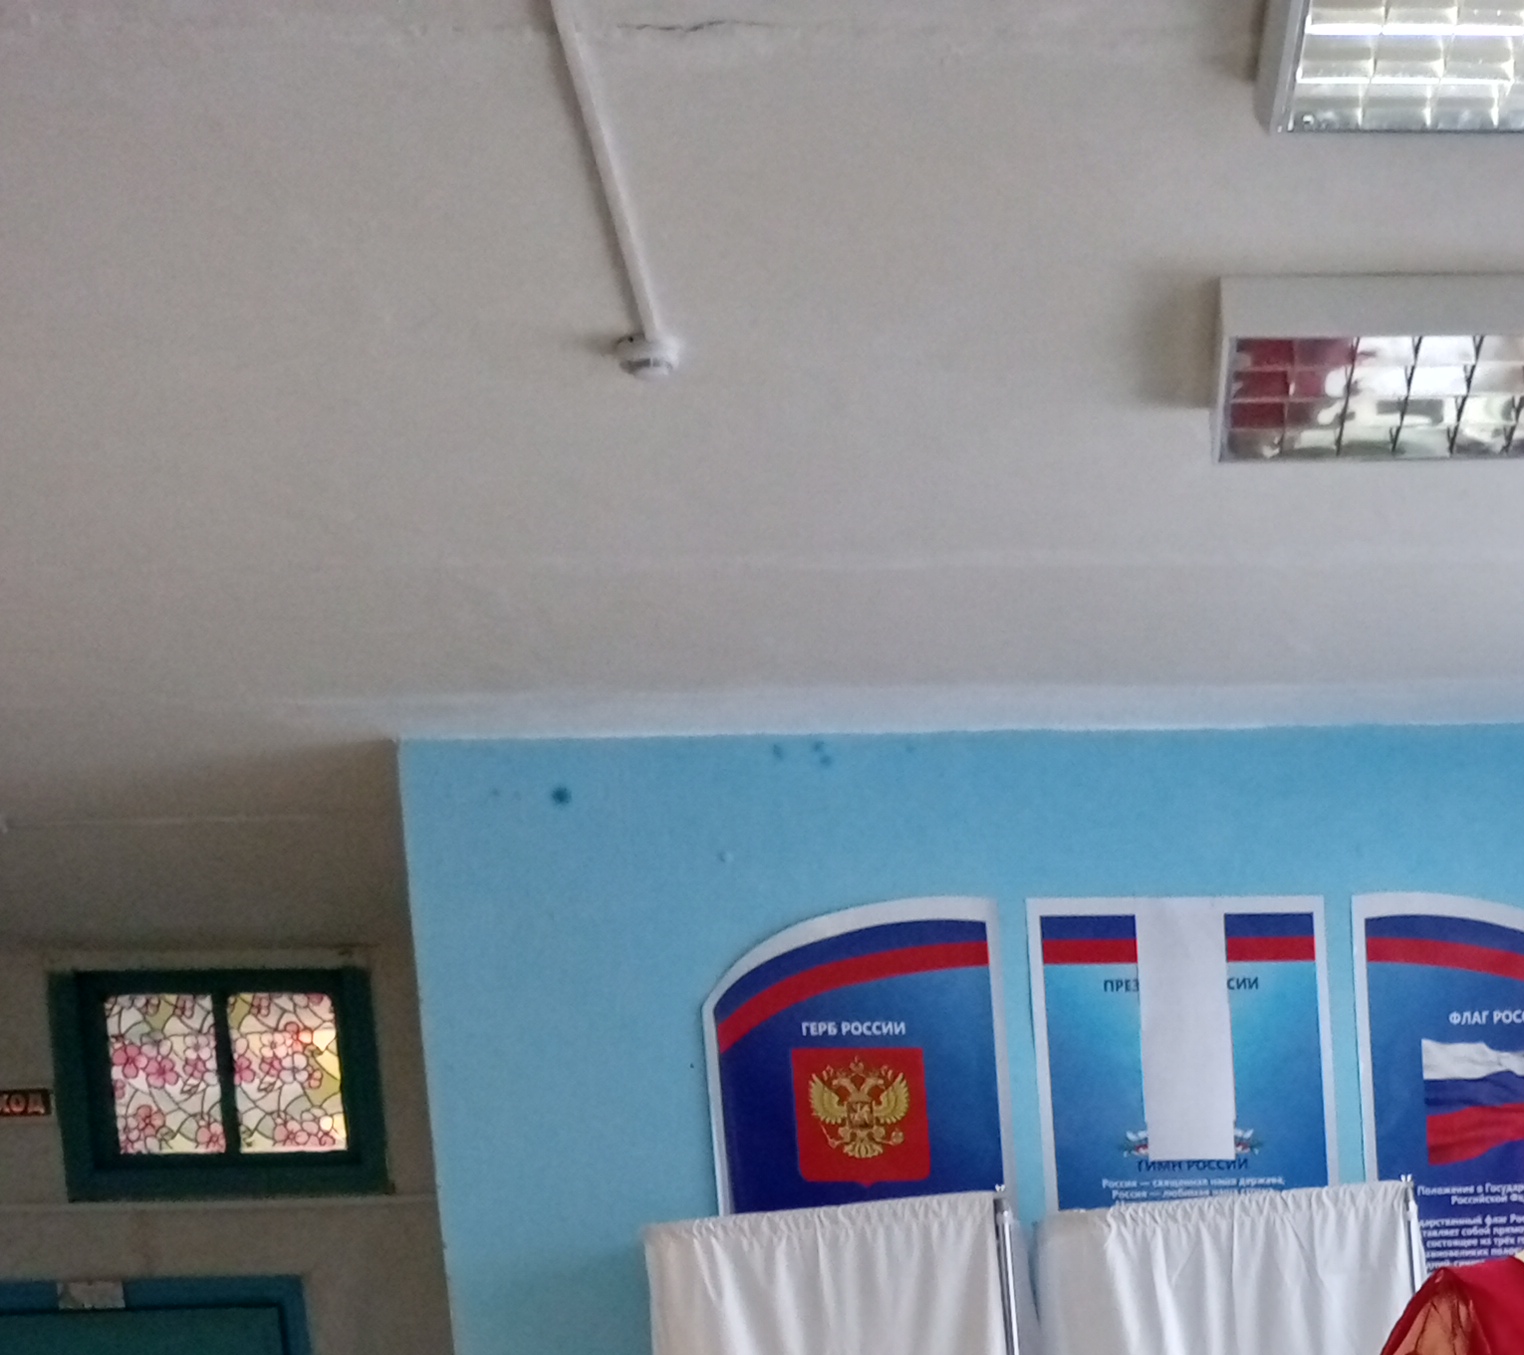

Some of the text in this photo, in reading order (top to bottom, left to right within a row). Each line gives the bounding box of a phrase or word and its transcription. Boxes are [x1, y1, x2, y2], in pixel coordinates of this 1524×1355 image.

[1103, 977, 1259, 993] ПРЕЗ СИИ
[1448, 1010, 1489, 1025] ФЛАГ
[801, 1021, 906, 1036] ГЕРБ РОССИИ
[1186, 1158, 1249, 1171] РОССИИ
